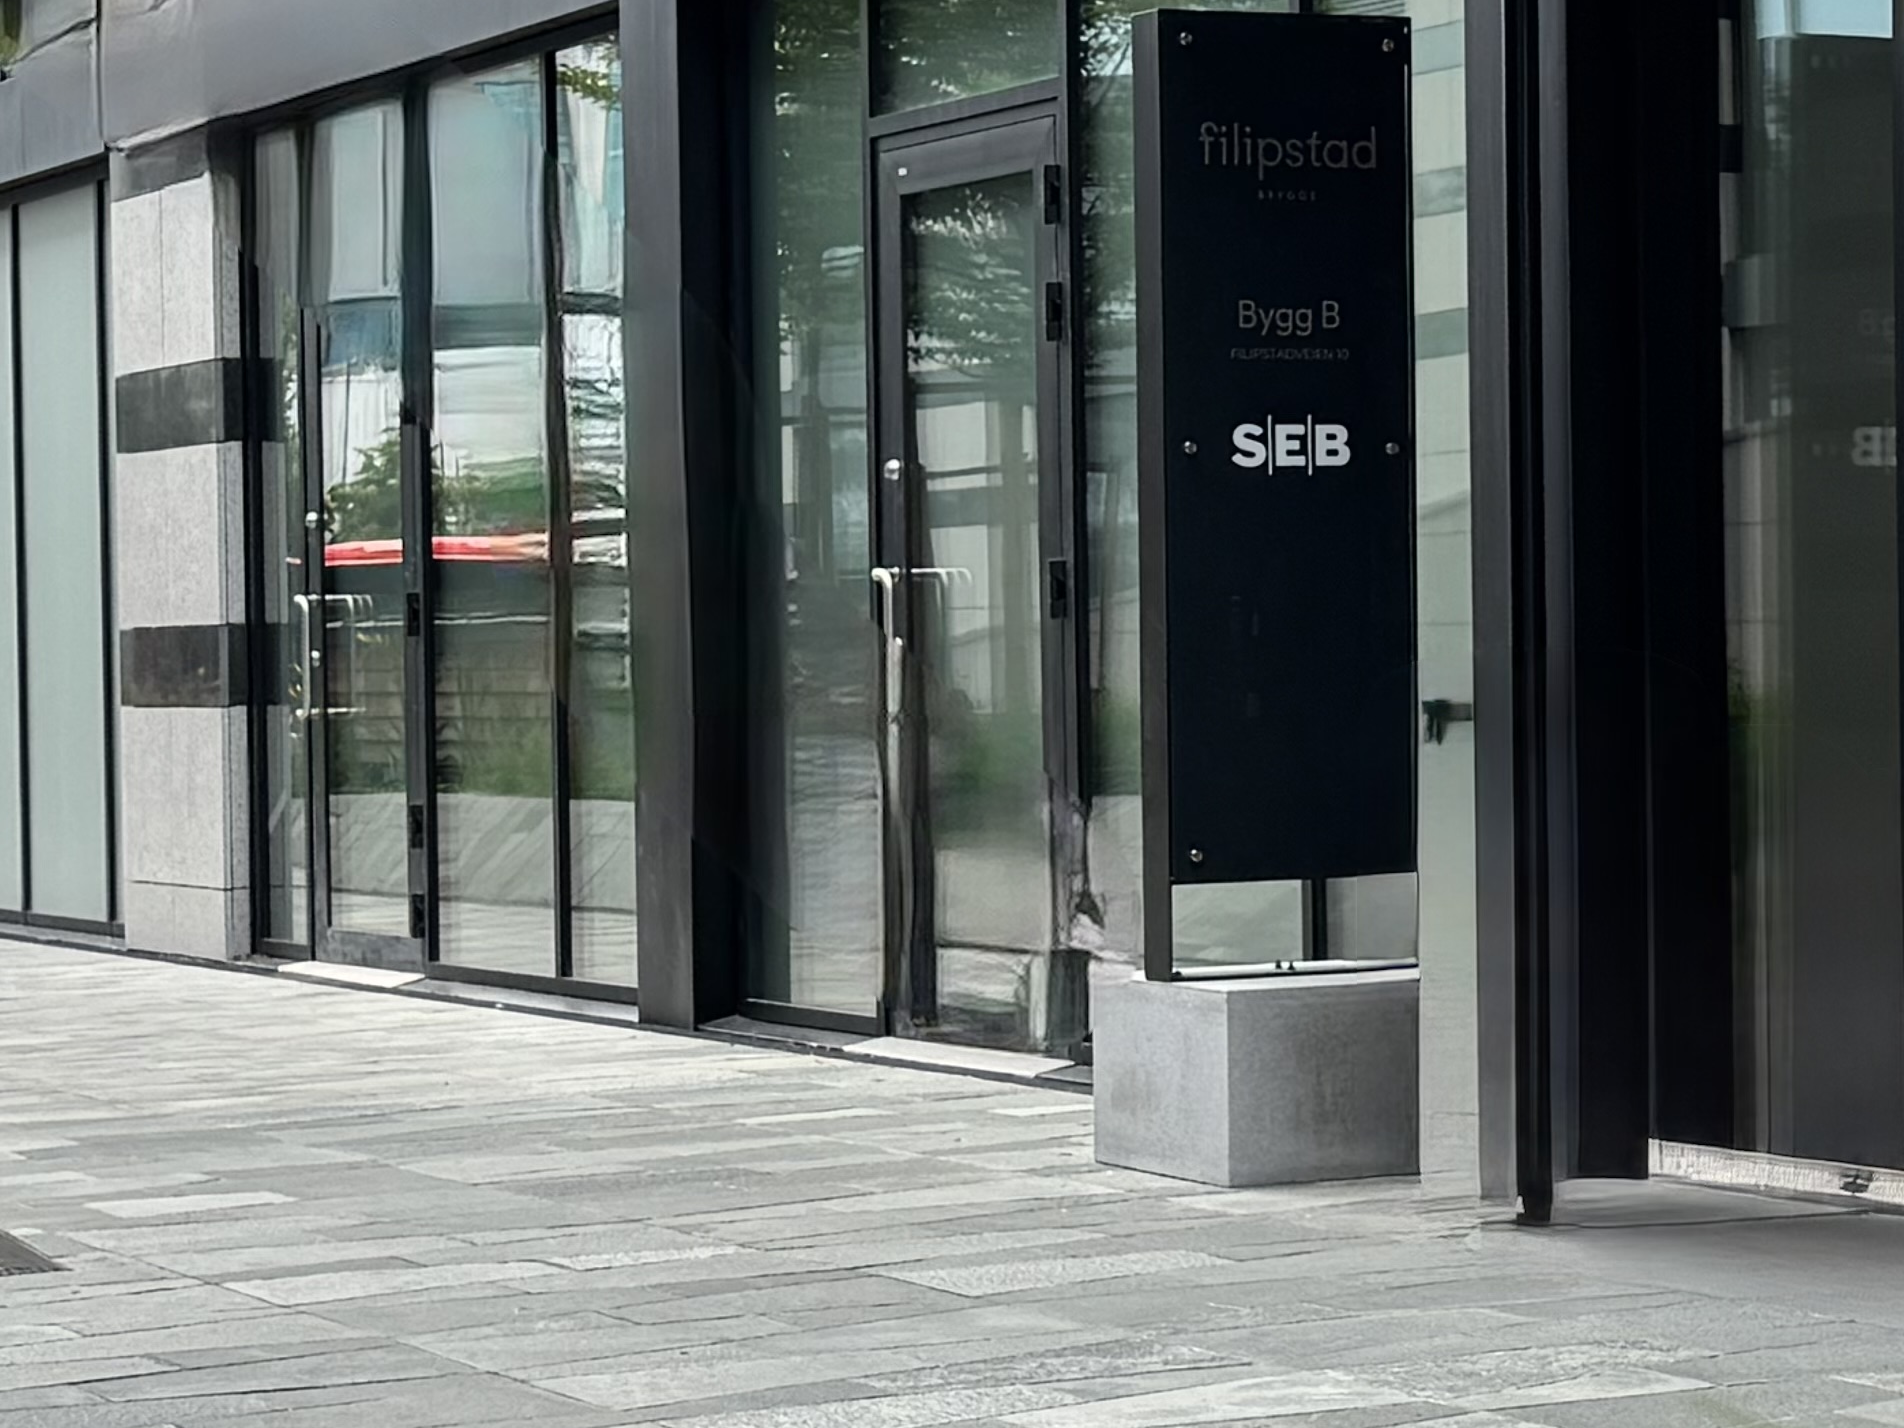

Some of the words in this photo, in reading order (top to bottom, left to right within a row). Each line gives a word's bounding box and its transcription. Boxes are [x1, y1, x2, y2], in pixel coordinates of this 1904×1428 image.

[1198, 121, 1378, 181] filipstad
[1237, 299, 1313, 337] Bygg
[1321, 299, 1341, 329] B
[1230, 416, 1352, 474] SEB
